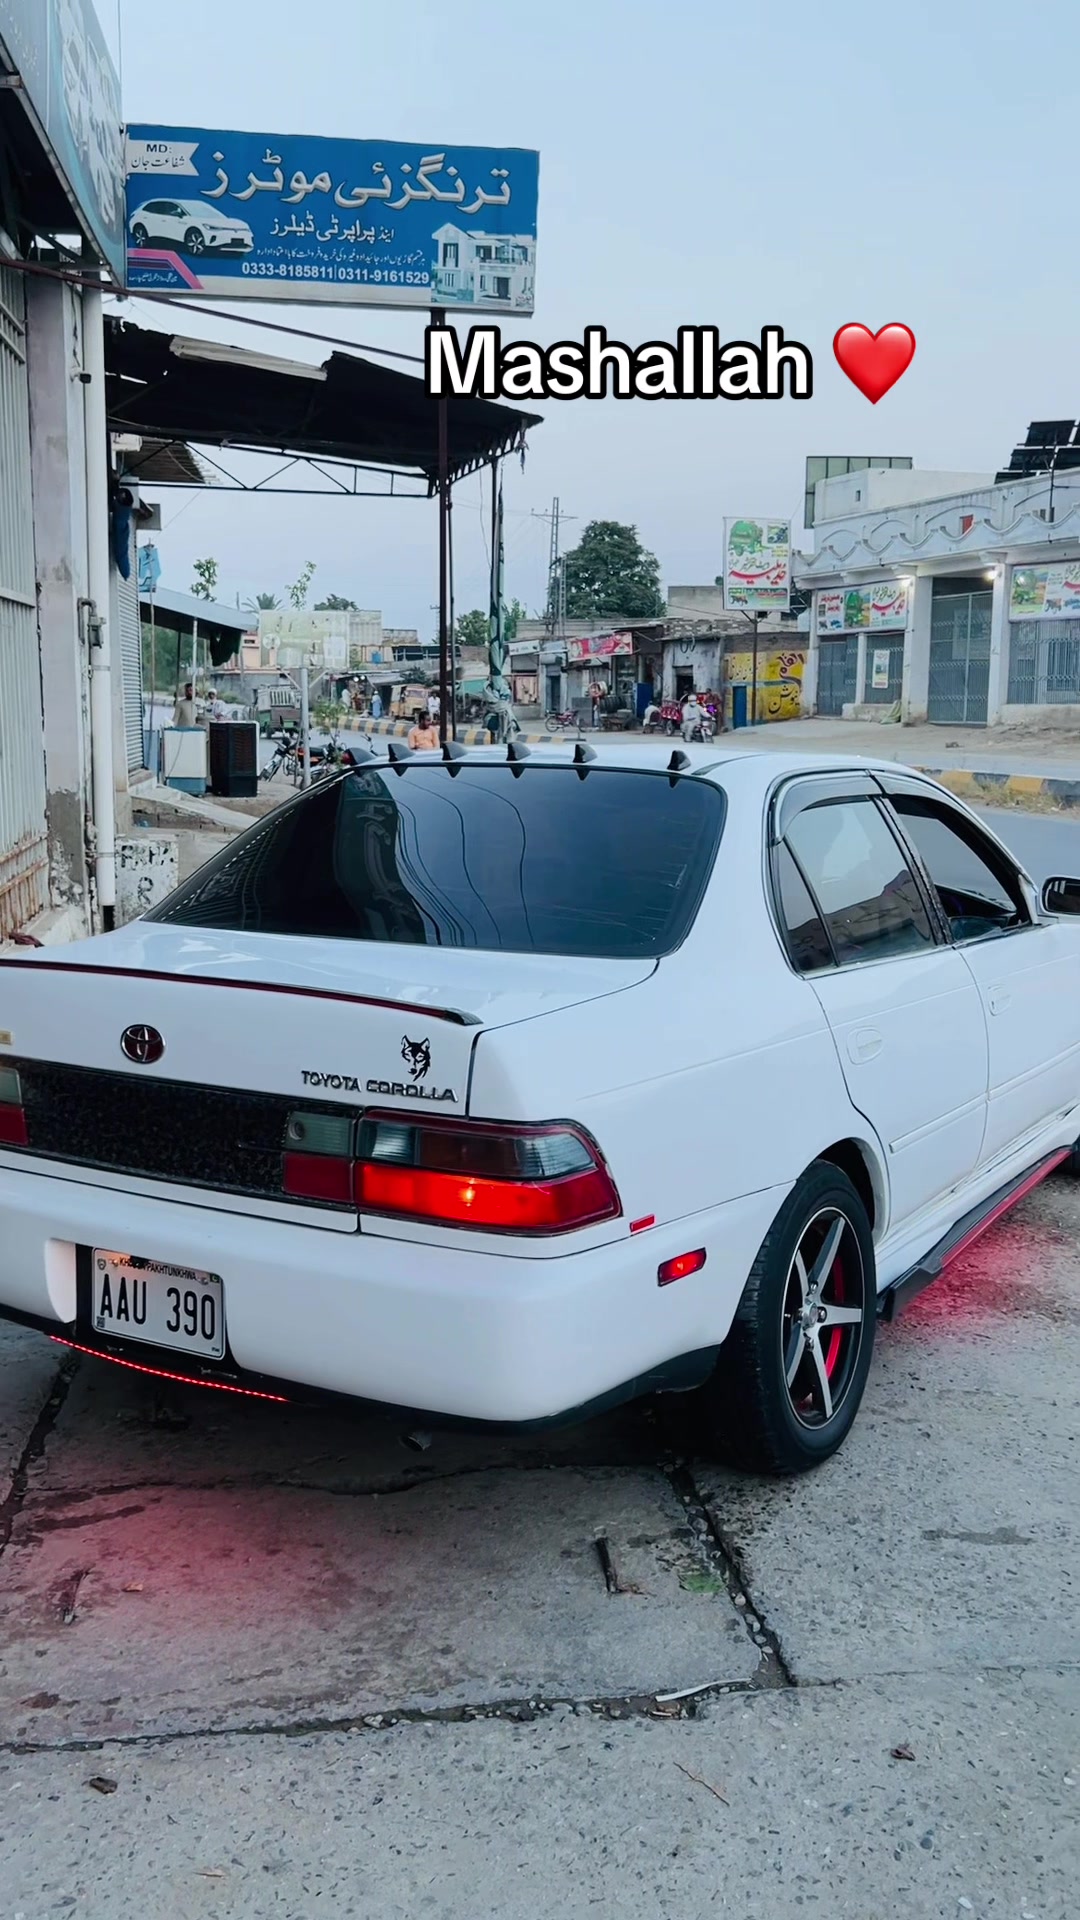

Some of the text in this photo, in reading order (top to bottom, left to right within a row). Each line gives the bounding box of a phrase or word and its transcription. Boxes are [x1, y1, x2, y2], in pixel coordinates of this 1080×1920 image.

[131, 156, 149, 171] جان
[200, 149, 511, 214] ترنگزئی موٹرز
[270, 210, 315, 236] ڈیلرز
[315, 214, 375, 244] پراپرٹی
[301, 1070, 459, 1103] TOYOTA COROLLA
[100, 1273, 216, 1341] AAU 390
